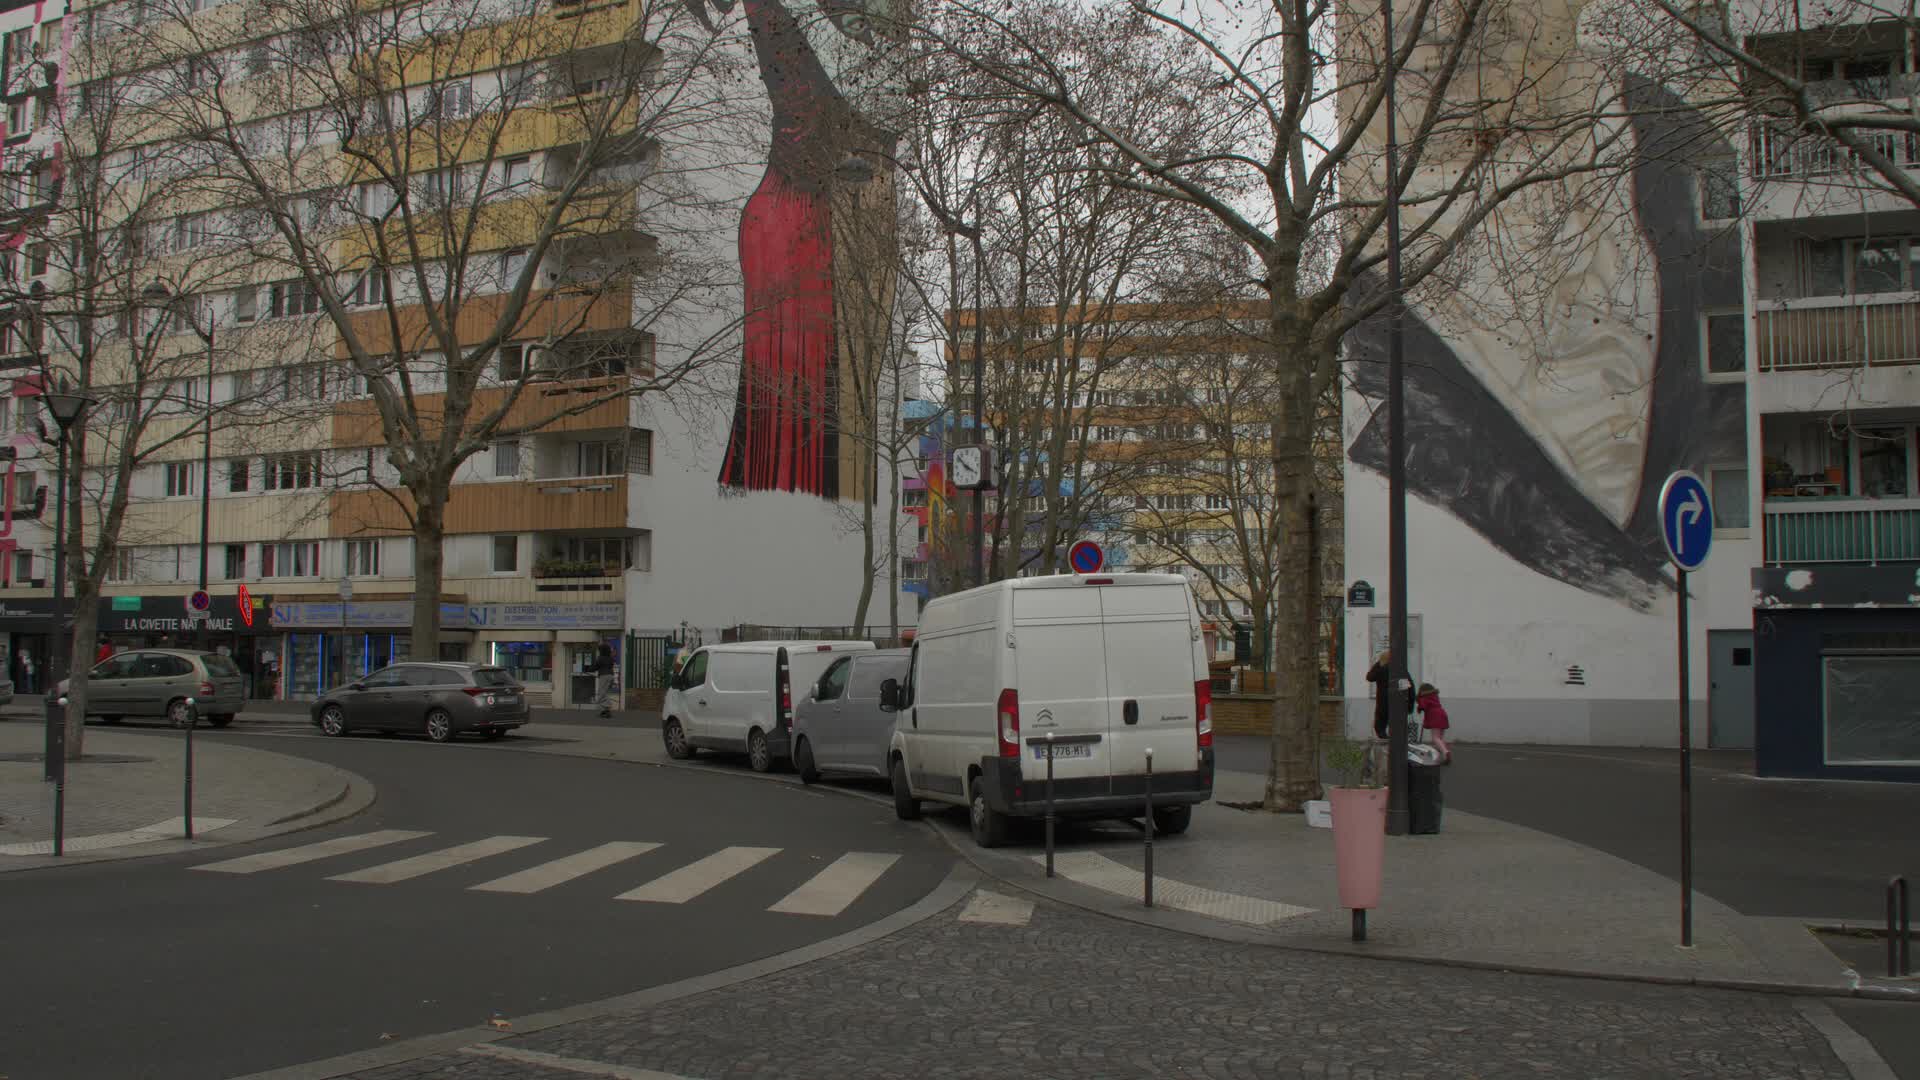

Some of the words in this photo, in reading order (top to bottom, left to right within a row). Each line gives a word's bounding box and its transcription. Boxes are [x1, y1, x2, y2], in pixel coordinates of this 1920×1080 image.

[124, 618, 138, 630] LA
[139, 618, 178, 630] CIVETTE
[180, 618, 233, 630] NATNALE
